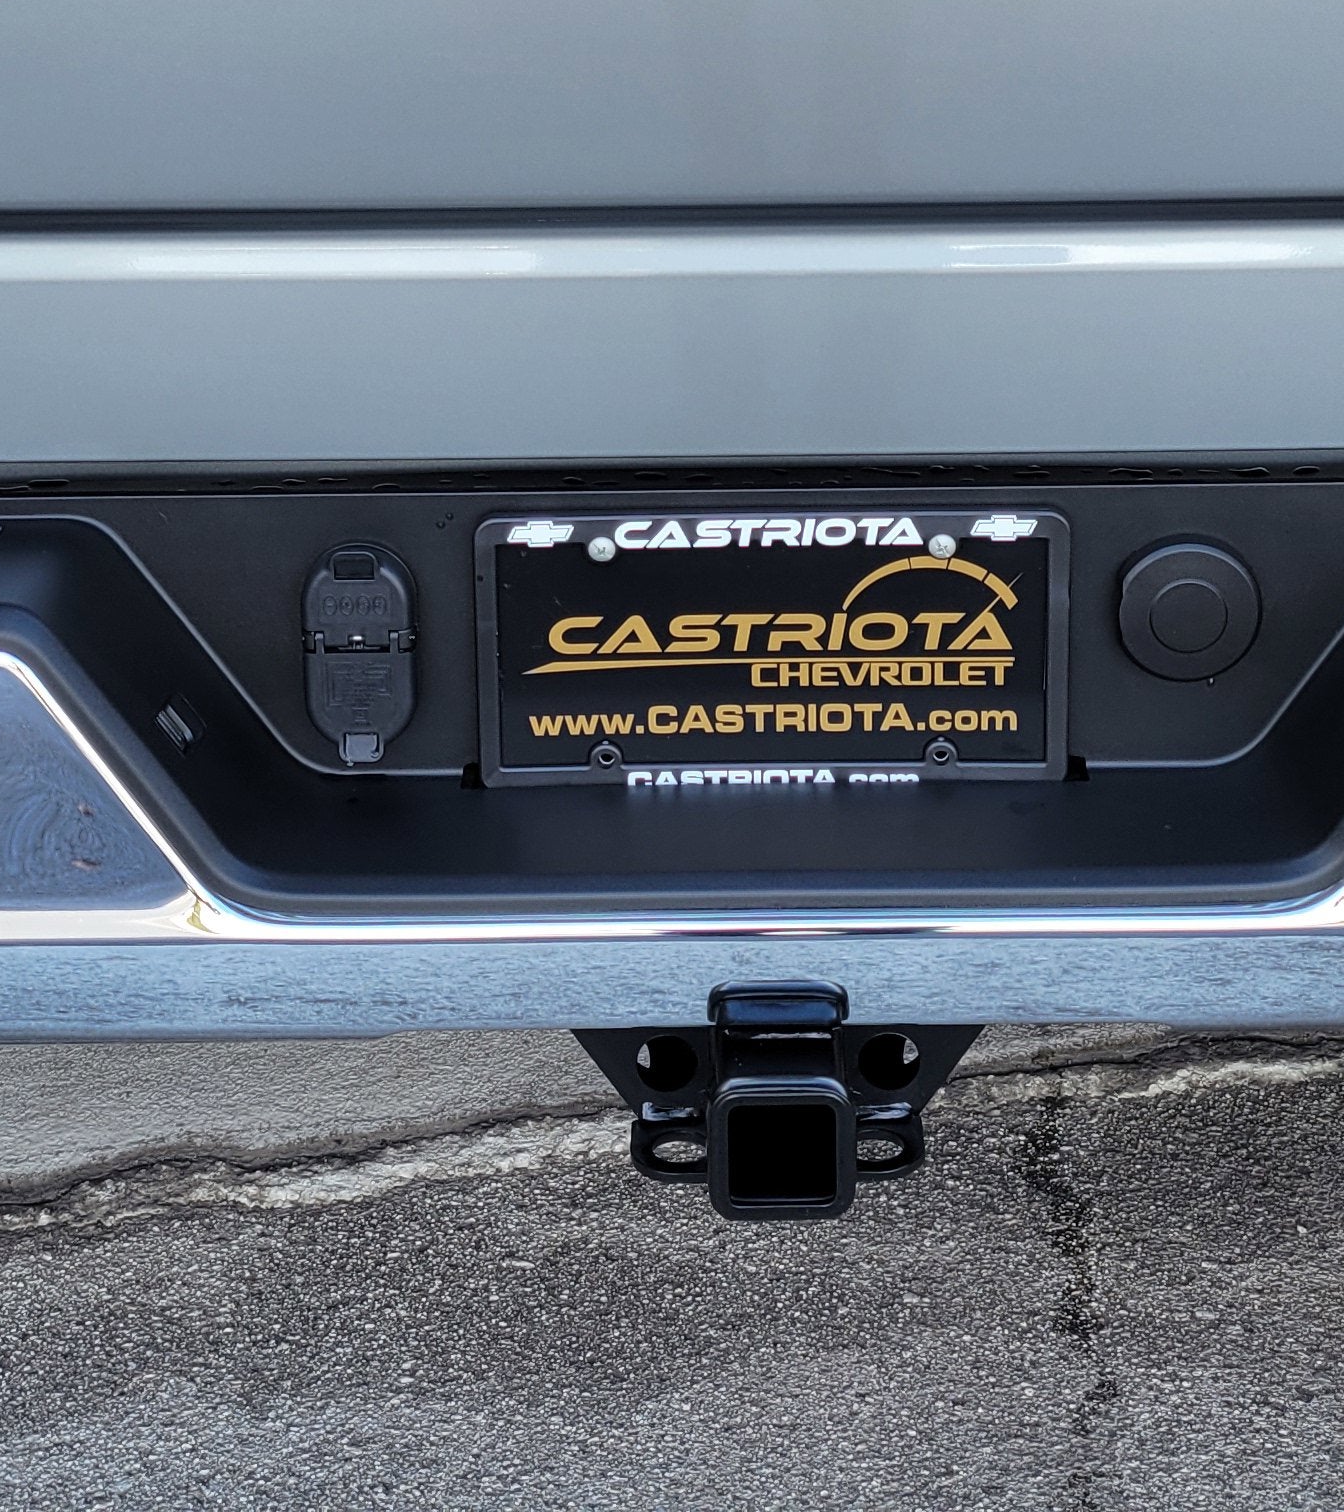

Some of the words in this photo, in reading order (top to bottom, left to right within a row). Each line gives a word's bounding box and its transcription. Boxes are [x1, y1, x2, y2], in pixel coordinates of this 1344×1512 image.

[613, 517, 924, 549] CASTRIOTA
[548, 611, 1013, 654] CASTRIOTA
[751, 662, 1014, 687] CHEVROLET
[529, 703, 1018, 737] www.CASTRIOTA.com
